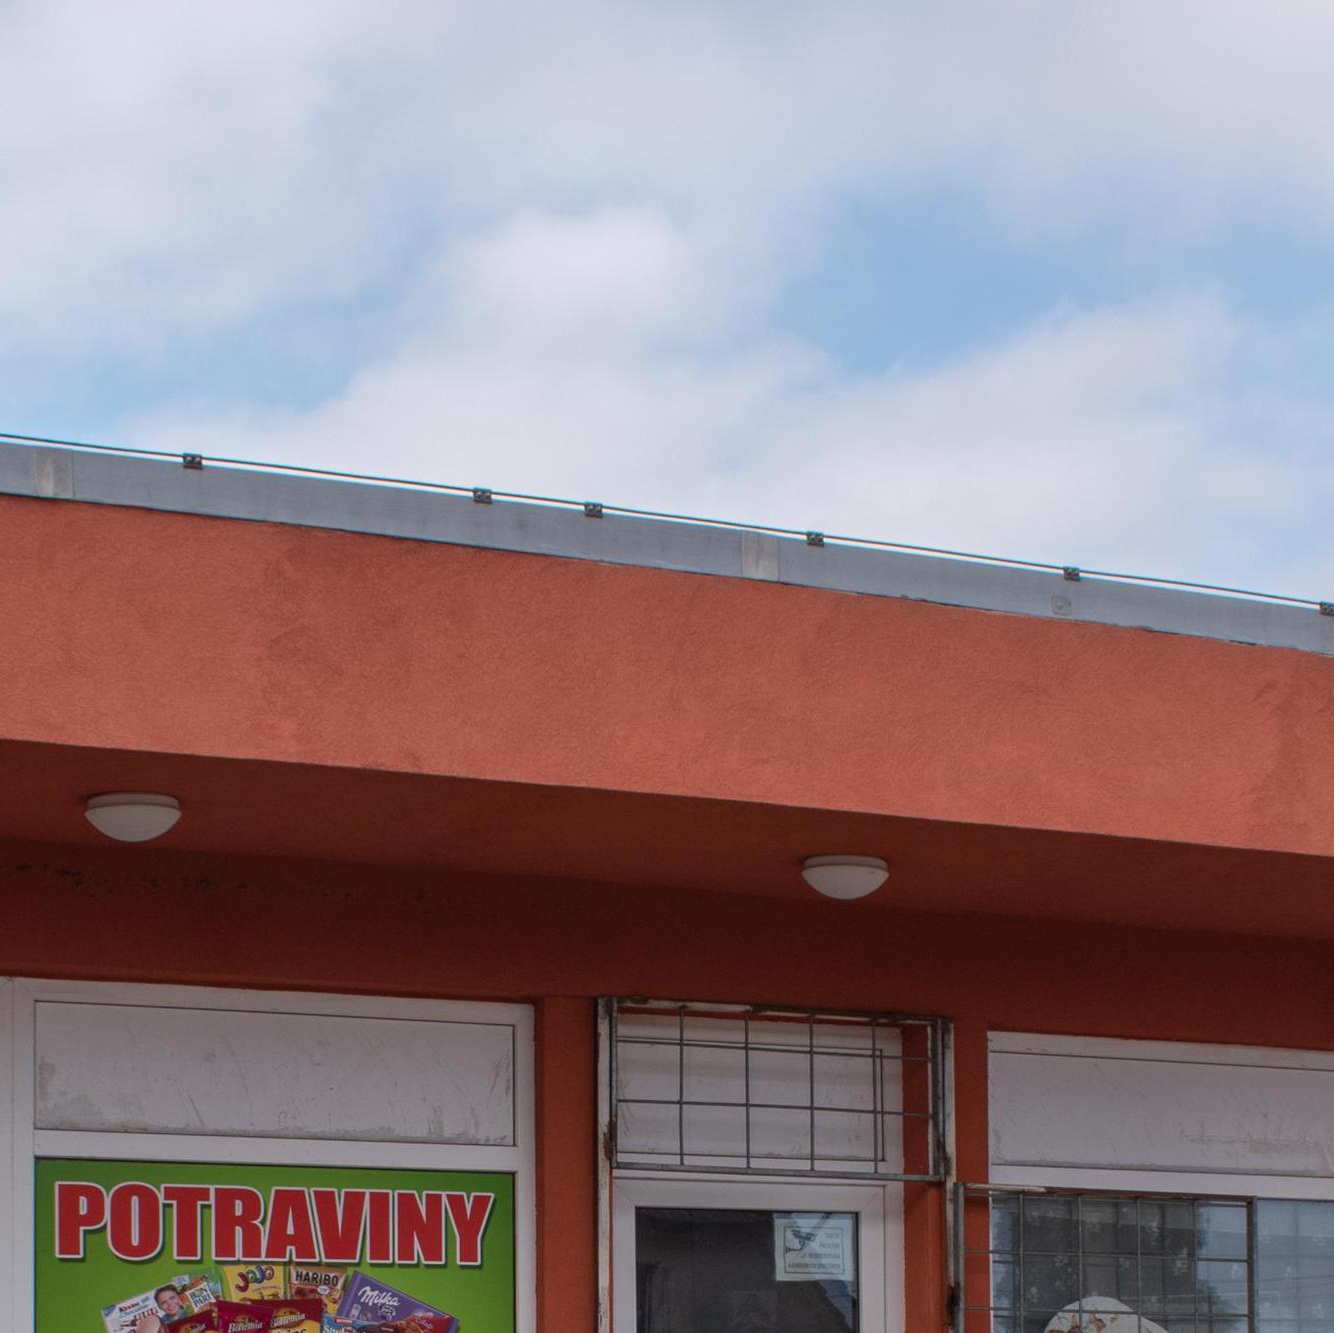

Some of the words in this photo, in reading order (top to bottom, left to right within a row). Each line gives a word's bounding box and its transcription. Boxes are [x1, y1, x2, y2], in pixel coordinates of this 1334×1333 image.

[54, 1181, 495, 1266] POTRAVINY
[295, 1270, 339, 1287] HARIBO
[357, 1285, 402, 1307] Milka
